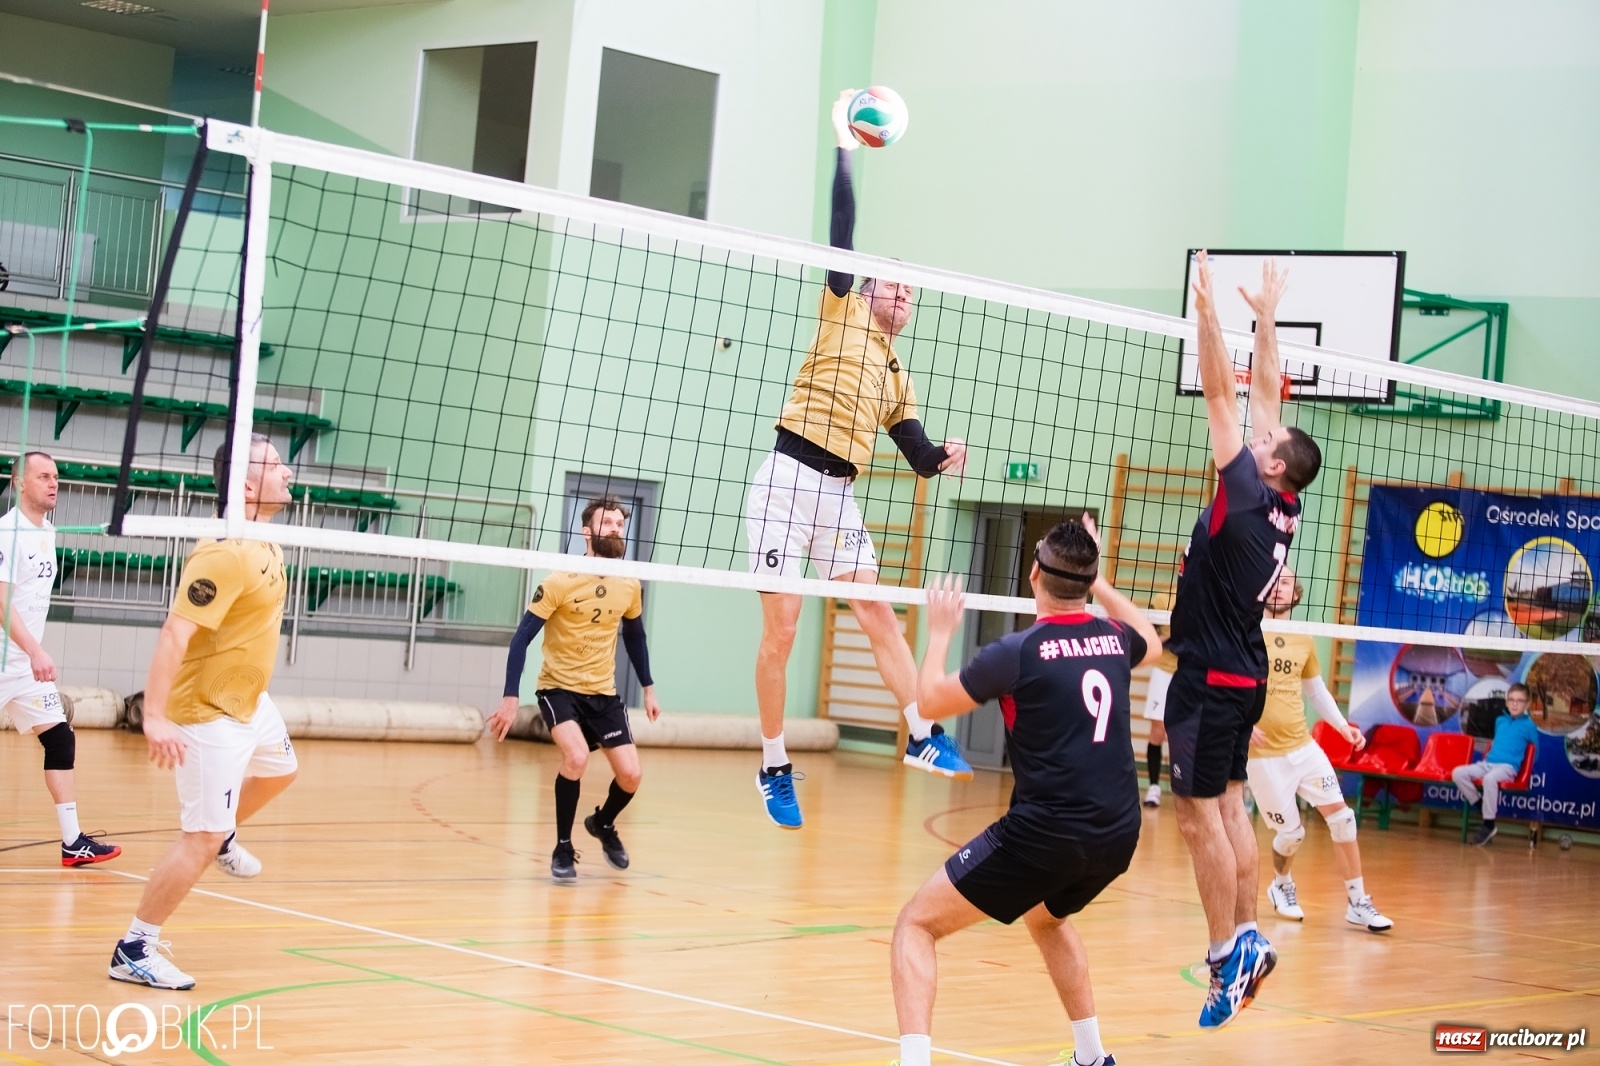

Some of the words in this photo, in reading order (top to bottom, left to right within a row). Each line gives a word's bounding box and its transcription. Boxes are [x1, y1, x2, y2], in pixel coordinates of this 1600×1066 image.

[765, 548, 779, 568] 6
[37, 561, 53, 578] 23
[1257, 542, 1287, 602] 7
[590, 608, 603, 624] 2
[1039, 635, 1125, 661] #RAJCHEL
[1273, 657, 1293, 675] 88
[1081, 668, 1113, 743] 9
[224, 789, 232, 809] 1
